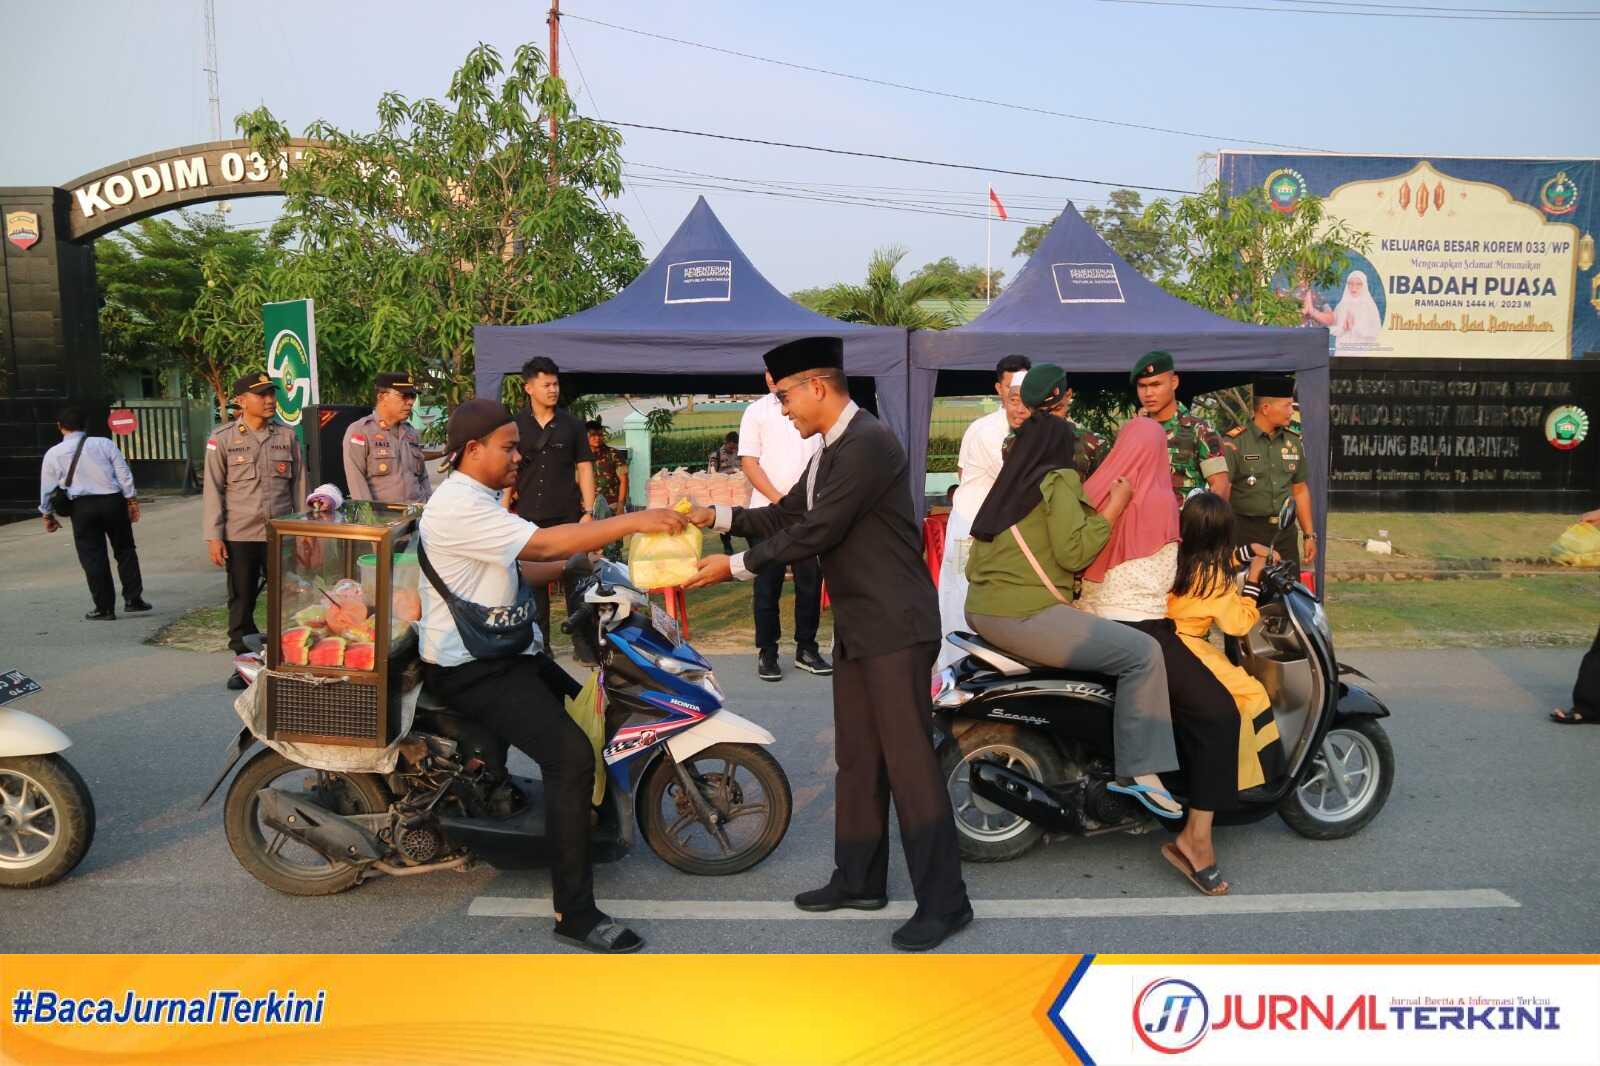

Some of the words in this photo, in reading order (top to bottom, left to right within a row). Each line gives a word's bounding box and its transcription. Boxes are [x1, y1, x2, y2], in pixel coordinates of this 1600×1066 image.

[75, 157, 208, 218] KODIM
[221, 151, 316, 182] 031
[1381, 239, 1440, 252] KELUARGA
[1444, 240, 1480, 252] BESAR
[1484, 241, 1522, 253] KOREM
[1388, 275, 1478, 295] IBADAH
[1484, 277, 1557, 296] PUASA
[1414, 299, 1463, 308] RAMADHAN
[1466, 300, 1486, 308] 1444
[1501, 301, 1521, 309] 2023
[1342, 435, 1406, 456] TANJUNG
[1410, 435, 1451, 456] BALAI
[670, 698, 700, 712] HONDA
[987, 708, 1050, 725] Scoopy
